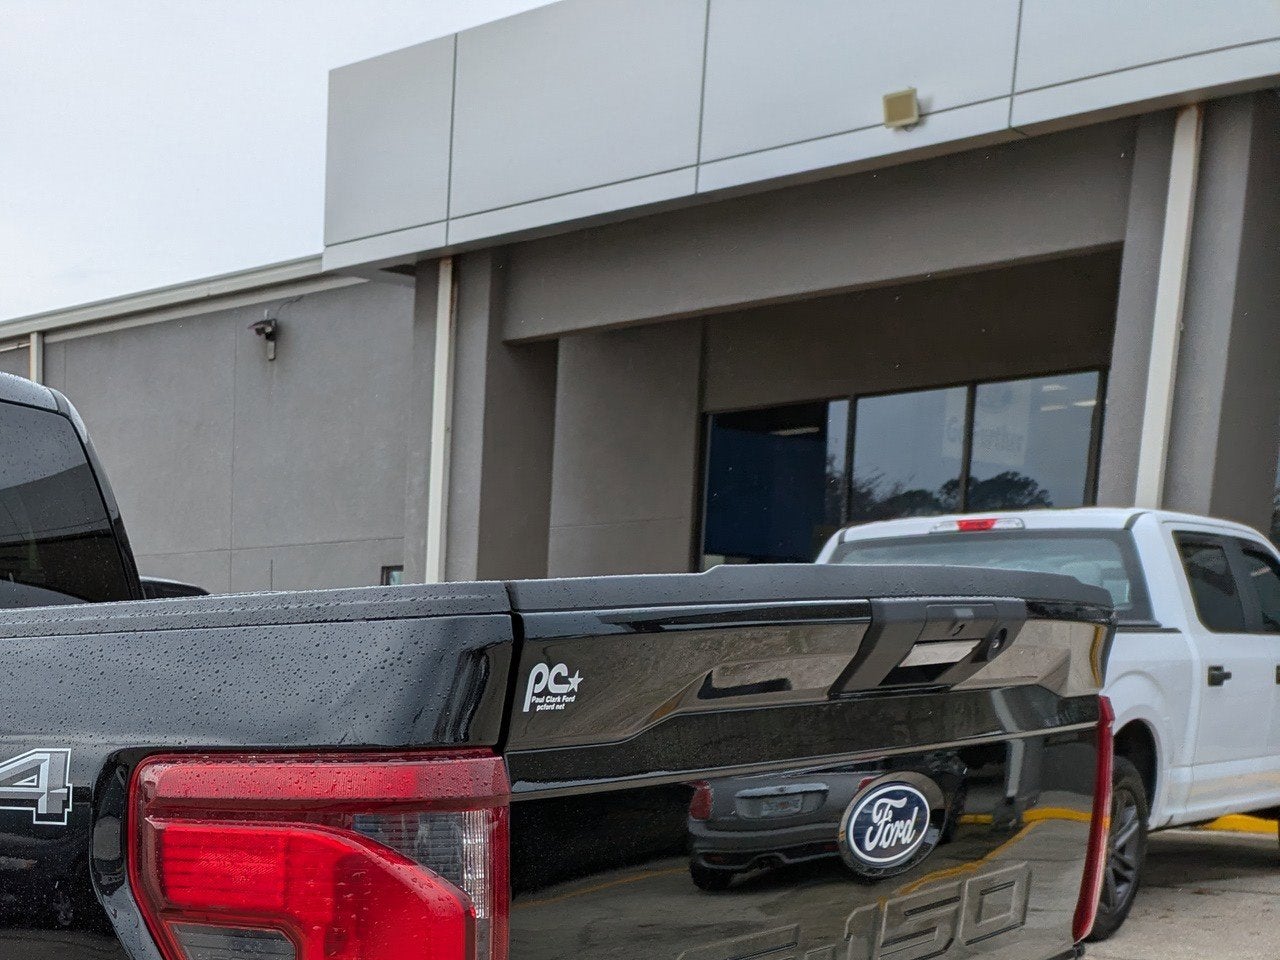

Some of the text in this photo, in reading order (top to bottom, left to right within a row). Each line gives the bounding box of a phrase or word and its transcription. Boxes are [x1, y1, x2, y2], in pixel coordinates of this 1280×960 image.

[531, 695, 576, 703] Paul Clark Ford
[865, 797, 919, 851] Ford
